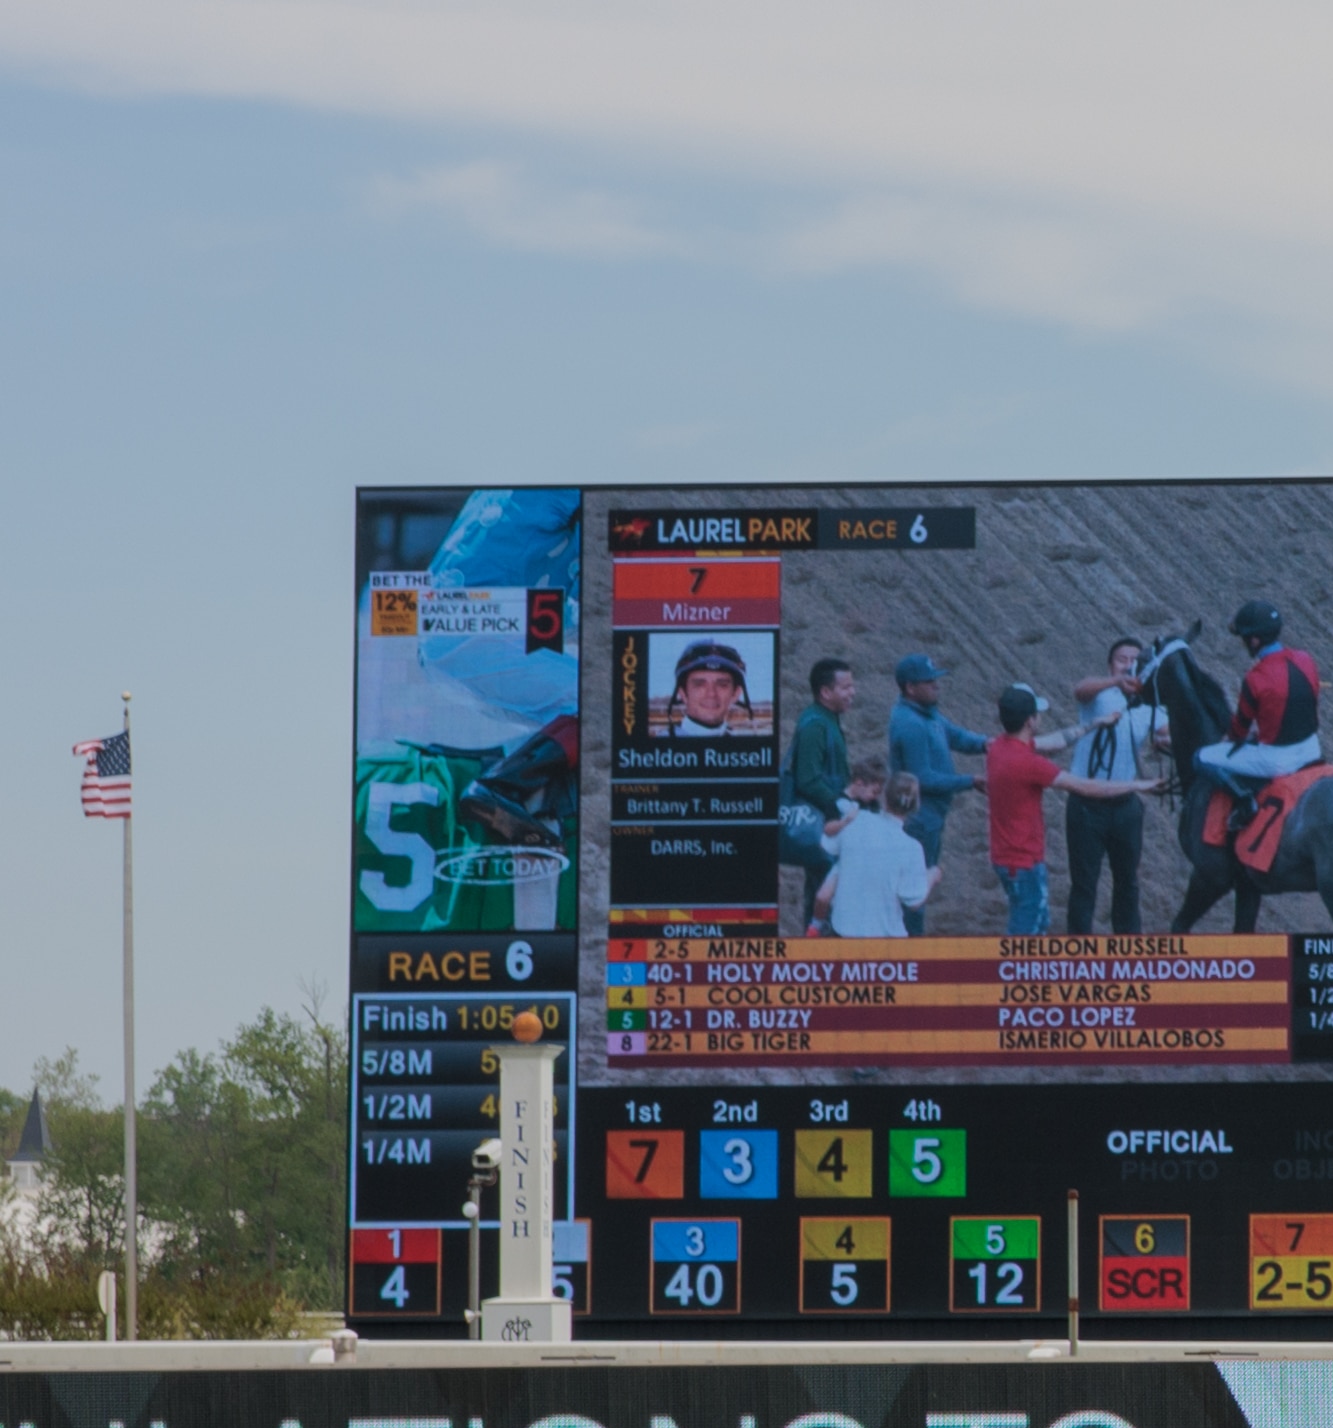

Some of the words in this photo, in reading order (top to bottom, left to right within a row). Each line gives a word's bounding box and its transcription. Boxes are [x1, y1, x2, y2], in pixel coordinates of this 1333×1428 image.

[838, 520, 897, 540] RACE
[909, 514, 928, 543] 6
[372, 575, 401, 587] BET
[403, 575, 431, 586] THE
[689, 568, 708, 594] 7
[375, 591, 417, 611] 12%
[421, 604, 459, 615] EARLY
[461, 604, 469, 615] &
[472, 604, 501, 615] LATE
[662, 602, 731, 621] Mizner
[423, 618, 479, 632] VALUE
[482, 617, 520, 632] PICK
[529, 594, 561, 640] 5
[622, 636, 638, 736] JOCKEY
[618, 747, 698, 768] Sheldon
[704, 746, 772, 767] Russell
[614, 784, 659, 794] TRAINER
[627, 798, 689, 816] Brittany
[692, 799, 706, 813] T.
[710, 798, 763, 813] Russell
[613, 826, 655, 836] OWNER
[359, 781, 439, 912] 5
[651, 839, 707, 857] DARRS,
[711, 839, 738, 855] Inc.
[493, 858, 558, 875] TODAY
[663, 924, 724, 938] OFFICIAL
[623, 942, 634, 958] 7
[655, 941, 690, 958] 2-5
[707, 939, 787, 958] MIZNER
[999, 938, 1099, 956] SHELDON
[1106, 936, 1188, 955] RUSSELL
[388, 951, 491, 981] RACE
[505, 940, 534, 981] 6
[622, 966, 634, 982] 3
[648, 964, 693, 982] 40-1
[707, 963, 765, 982] HOLY
[772, 963, 834, 981] MOLY
[841, 962, 919, 981] MITOLE
[998, 961, 1106, 981] CHRISTIAN
[1112, 959, 1256, 980] MALDONADO
[622, 989, 634, 1006] 4
[654, 988, 686, 1005] 5-1
[707, 987, 773, 1005] COOL
[779, 986, 897, 1005] CUSTOMER
[999, 984, 1053, 1003] JOSE
[1060, 983, 1151, 1002] VARGAS
[363, 1005, 447, 1031] Finish
[622, 1012, 633, 1029] 5
[649, 1010, 693, 1029] 12-1
[707, 1010, 741, 1029] DR.
[749, 1010, 813, 1028] BUZZY
[998, 1007, 1065, 1027] PACO
[1071, 1006, 1136, 1026] LOPEZ
[621, 1035, 633, 1052] 8
[648, 1034, 693, 1051] 22-1
[707, 1033, 745, 1051] BIG
[752, 1033, 811, 1050] TIGER
[1000, 1030, 1087, 1050] ISMERIO
[1095, 1029, 1225, 1048] VILLALOBOS
[362, 1049, 433, 1076] 5/8M
[363, 1093, 432, 1120] 1/2M
[625, 1101, 662, 1123] 1st
[713, 1100, 758, 1122] 2nd
[809, 1100, 849, 1122] 3rd
[903, 1099, 941, 1121] 4th
[362, 1138, 431, 1165] 1/4M
[1106, 1129, 1234, 1154] OFFICIAL
[511, 1100, 531, 1238] FINISH
[628, 1139, 660, 1184] 7
[722, 1138, 754, 1184] 3
[816, 1138, 848, 1182] 4
[911, 1137, 942, 1183] 5
[387, 1229, 401, 1259] 1
[685, 1226, 705, 1257] 3
[835, 1226, 855, 1255] 4
[985, 1225, 1005, 1255] 5
[1133, 1223, 1155, 1254] 6
[1285, 1222, 1305, 1252] 7
[380, 1265, 410, 1309] 4
[664, 1263, 724, 1306] 40
[830, 1263, 859, 1305] 5
[968, 1263, 1025, 1304] 12
[1106, 1267, 1184, 1300] SCR
[1256, 1261, 1333, 1301] 2-5
